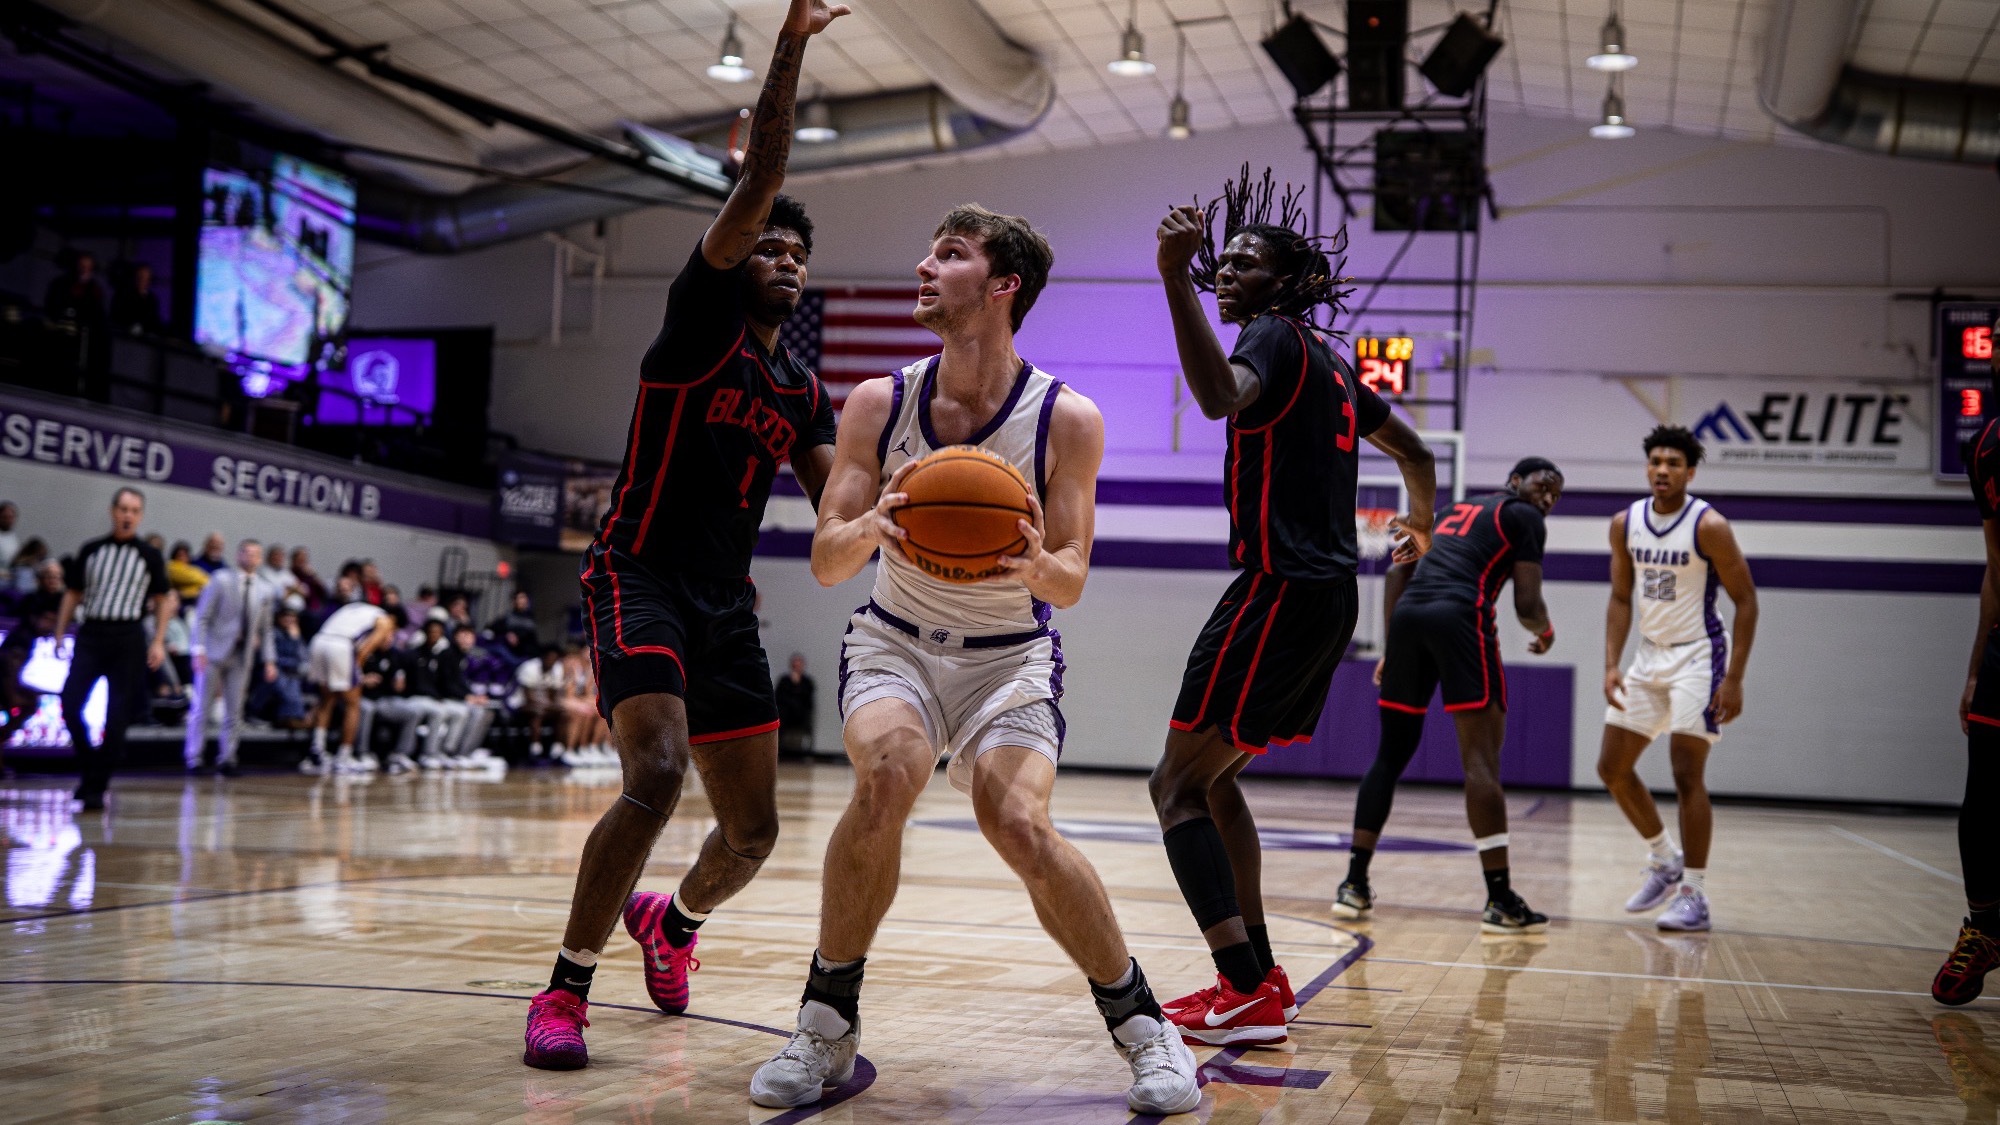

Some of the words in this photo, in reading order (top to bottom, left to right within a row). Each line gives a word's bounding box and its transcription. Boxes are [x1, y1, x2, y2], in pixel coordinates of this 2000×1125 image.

[1360, 359, 1403, 395] 24
[1746, 393, 1909, 445] ELITE
[1961, 389, 1981, 416] 3
[2, 413, 174, 482] SERVED
[211, 455, 355, 514] SECTION
[359, 484, 382, 520] B
[738, 455, 760, 508] 1
[1434, 503, 1485, 537] 21
[1643, 568, 1677, 601] 22
